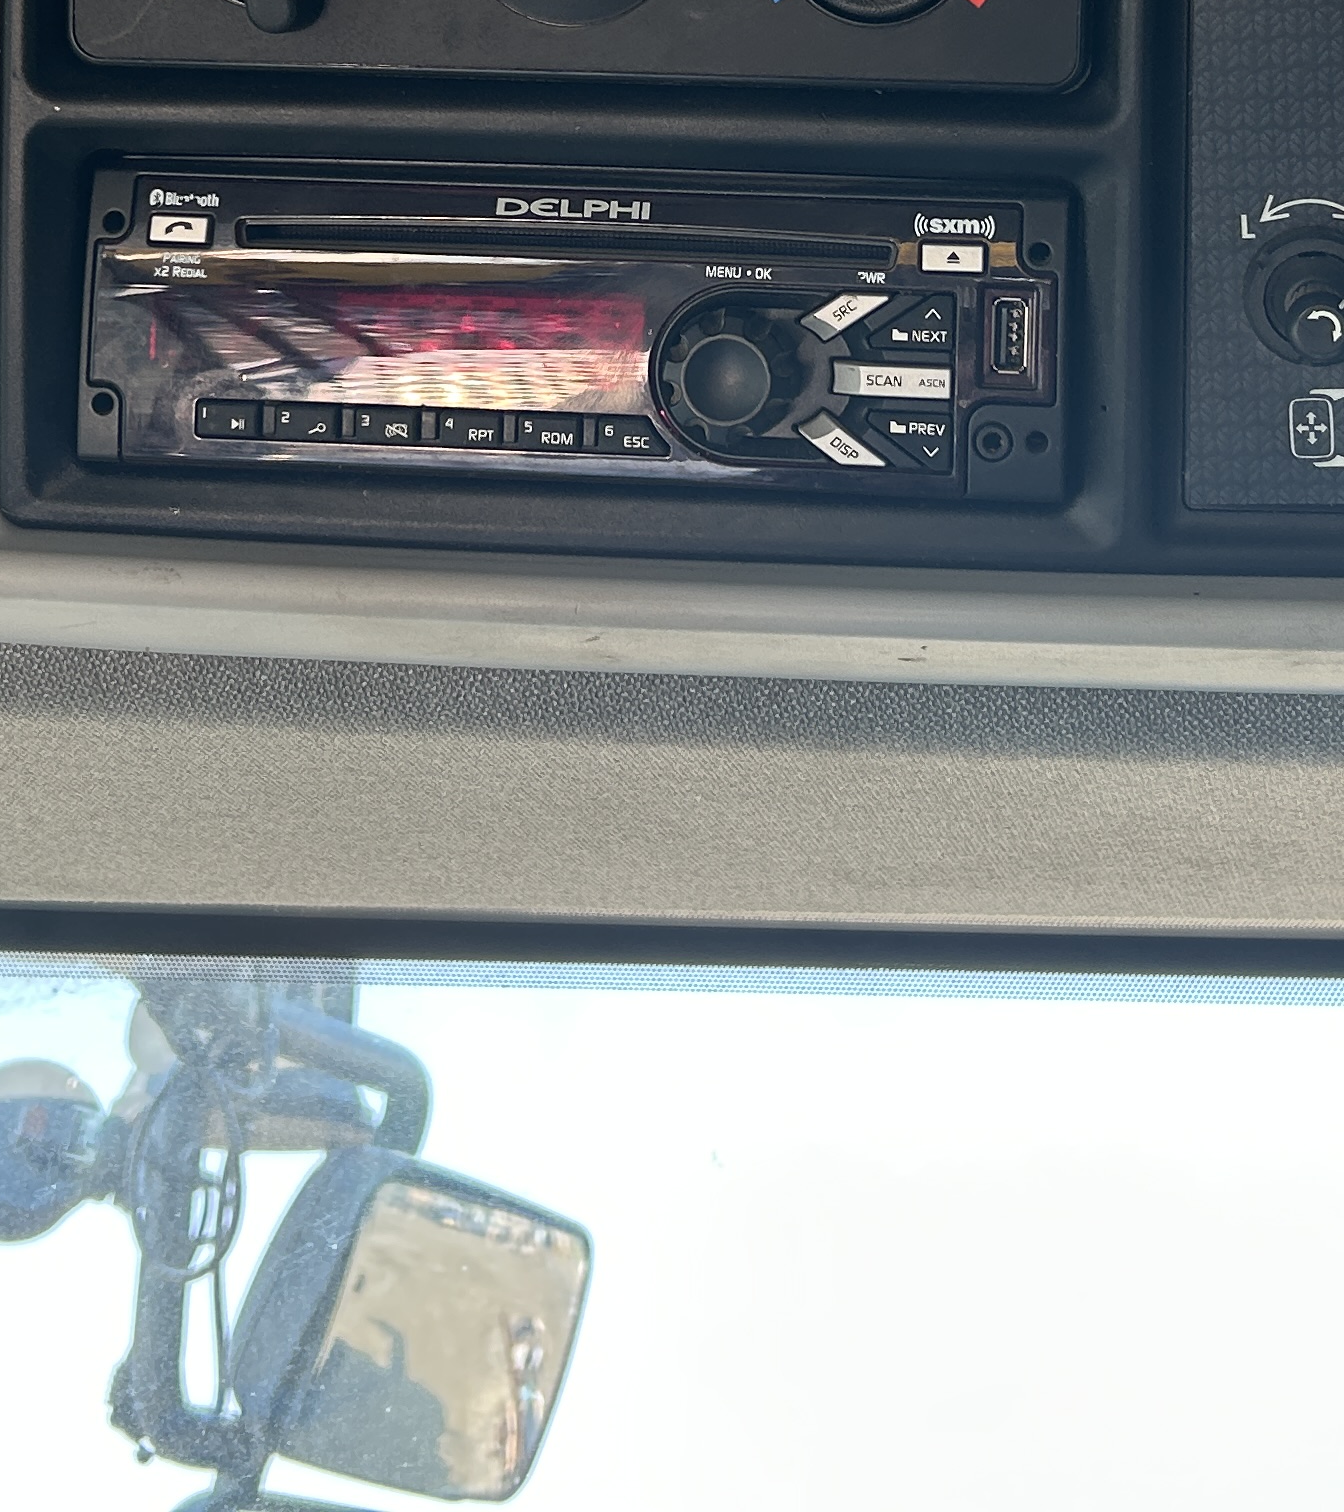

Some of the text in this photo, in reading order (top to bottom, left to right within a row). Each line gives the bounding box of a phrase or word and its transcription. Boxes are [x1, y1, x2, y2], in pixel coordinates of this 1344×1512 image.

[495, 197, 651, 220] DELPHI
[1240, 214, 1256, 239] L
[705, 265, 773, 280] MENU OK
[857, 271, 886, 284] PWR
[832, 299, 858, 322] SRC
[911, 330, 948, 343] NEXT
[866, 374, 946, 389] SCAN ASCN
[280, 411, 290, 424] 2
[361, 415, 370, 427] 3
[444, 417, 494, 442] 4 RPT
[524, 420, 574, 445] 5 RDM
[604, 424, 650, 449] 6 ESC
[908, 422, 946, 436] PREV
[829, 436, 859, 459] DISP
